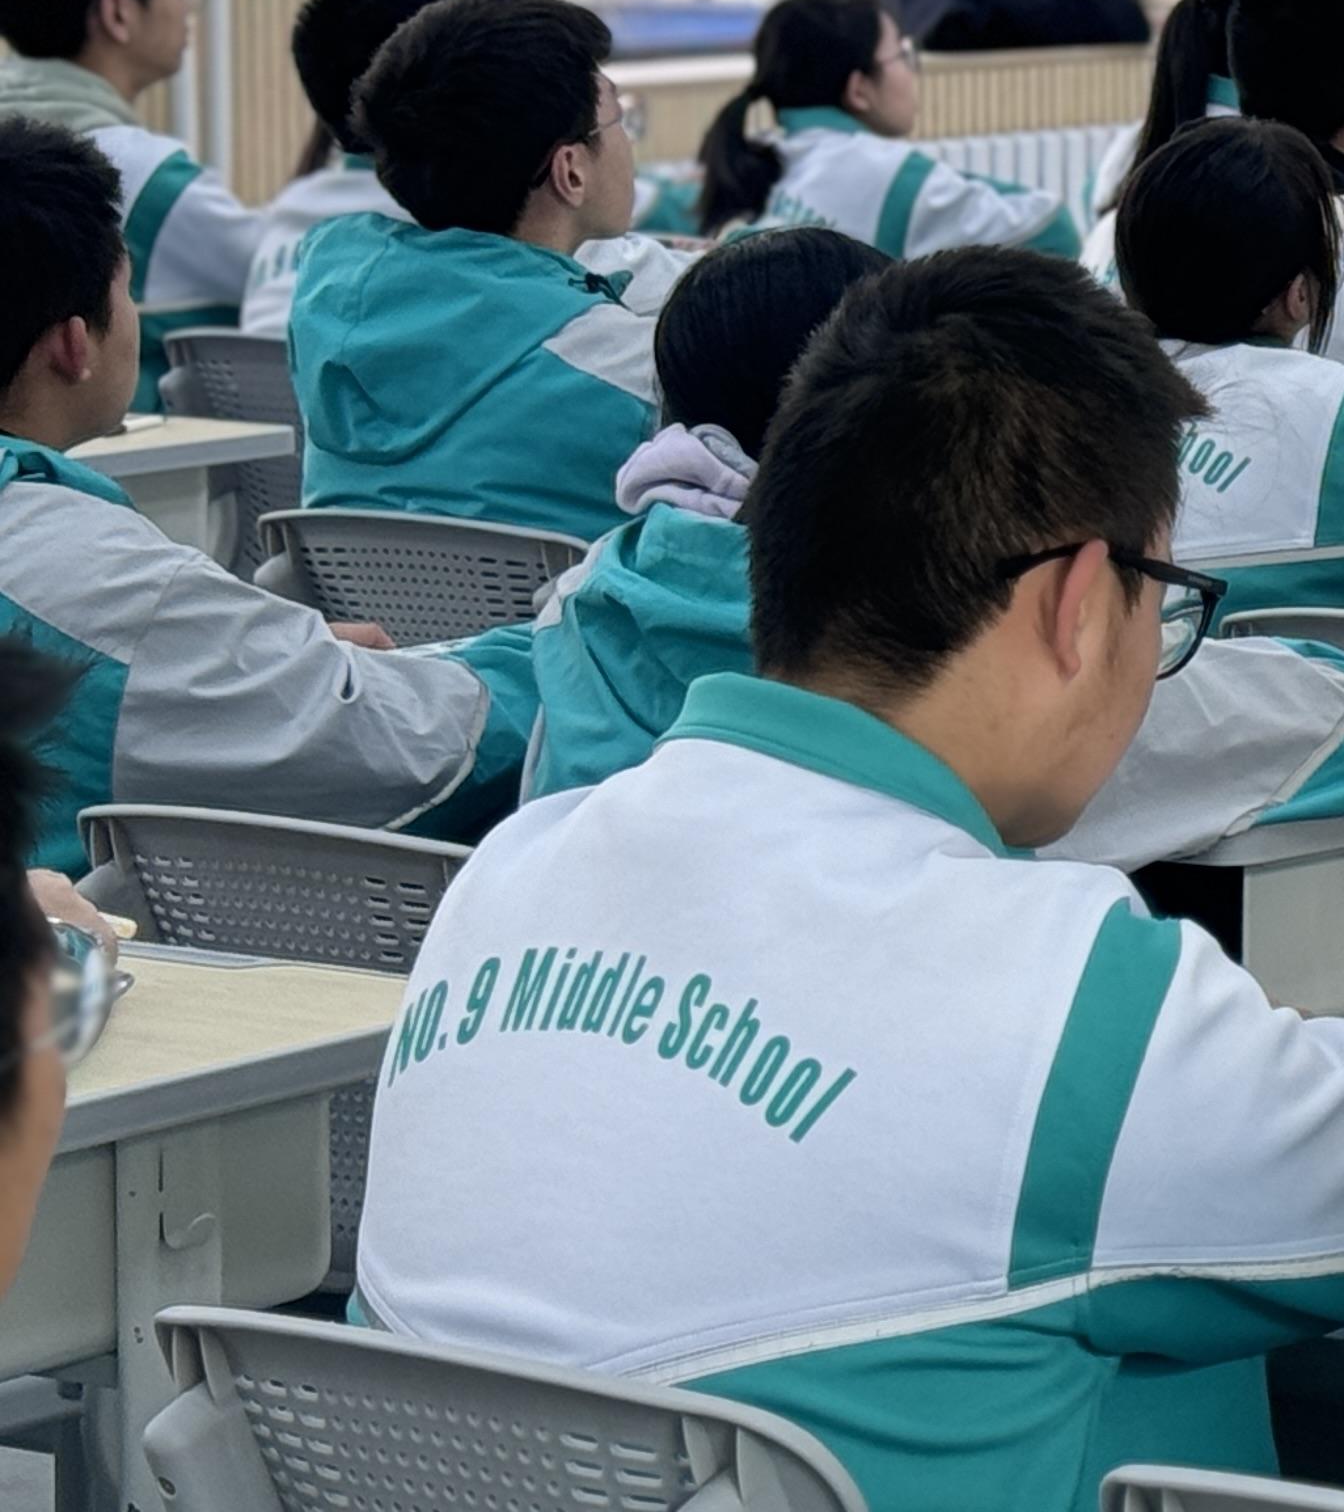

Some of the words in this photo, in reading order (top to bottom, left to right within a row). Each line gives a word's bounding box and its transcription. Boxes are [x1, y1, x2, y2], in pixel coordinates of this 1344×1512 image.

[387, 979, 449, 1090] NO.
[456, 956, 502, 1046] 9
[499, 946, 666, 1045] Middle
[657, 973, 858, 1144] School
